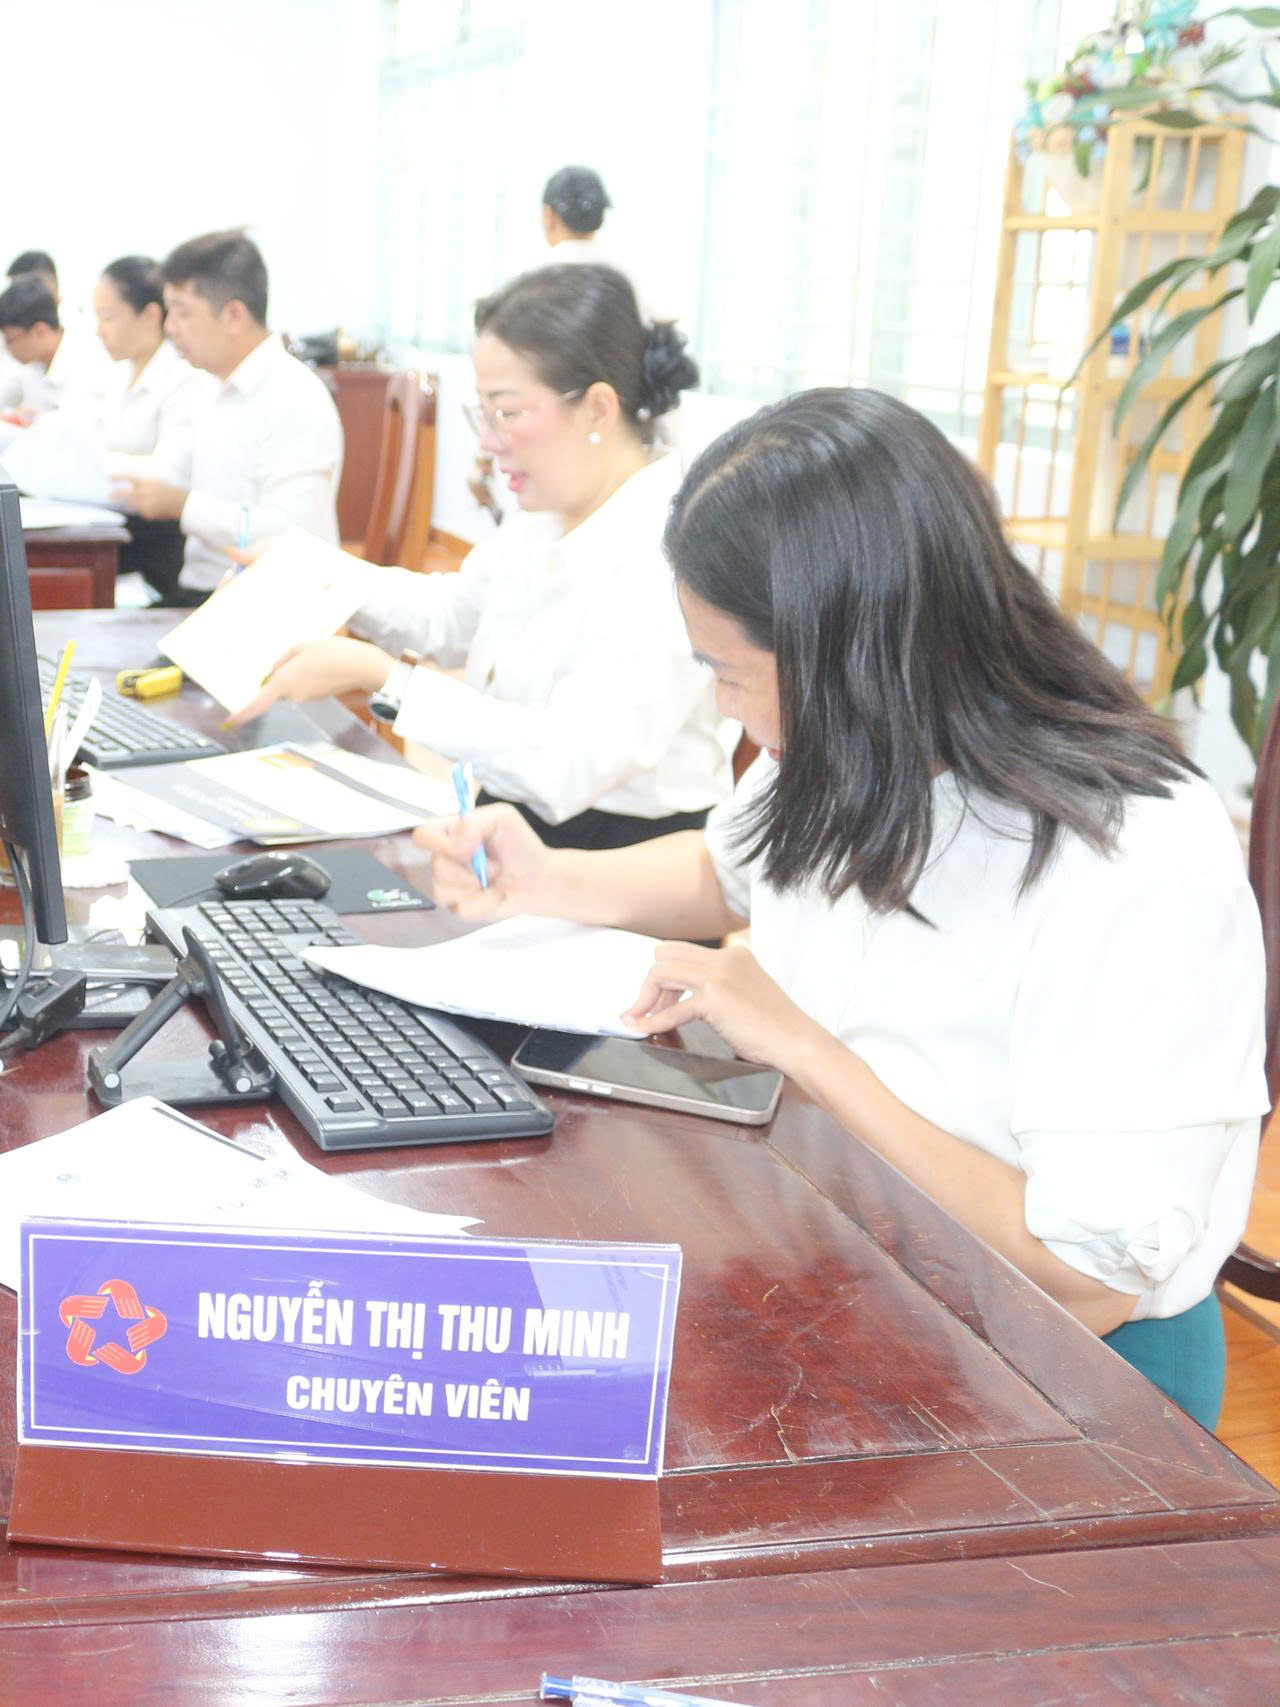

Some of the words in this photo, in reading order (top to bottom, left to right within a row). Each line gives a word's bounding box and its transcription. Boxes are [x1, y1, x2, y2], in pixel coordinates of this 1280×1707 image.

[199, 1281, 353, 1345] NGUYỄN
[367, 1302, 425, 1359] THỊ
[439, 1305, 511, 1353] THU
[524, 1309, 630, 1358] MINH
[287, 1374, 432, 1415] CHUYÊN
[446, 1379, 529, 1420] VIÊN
